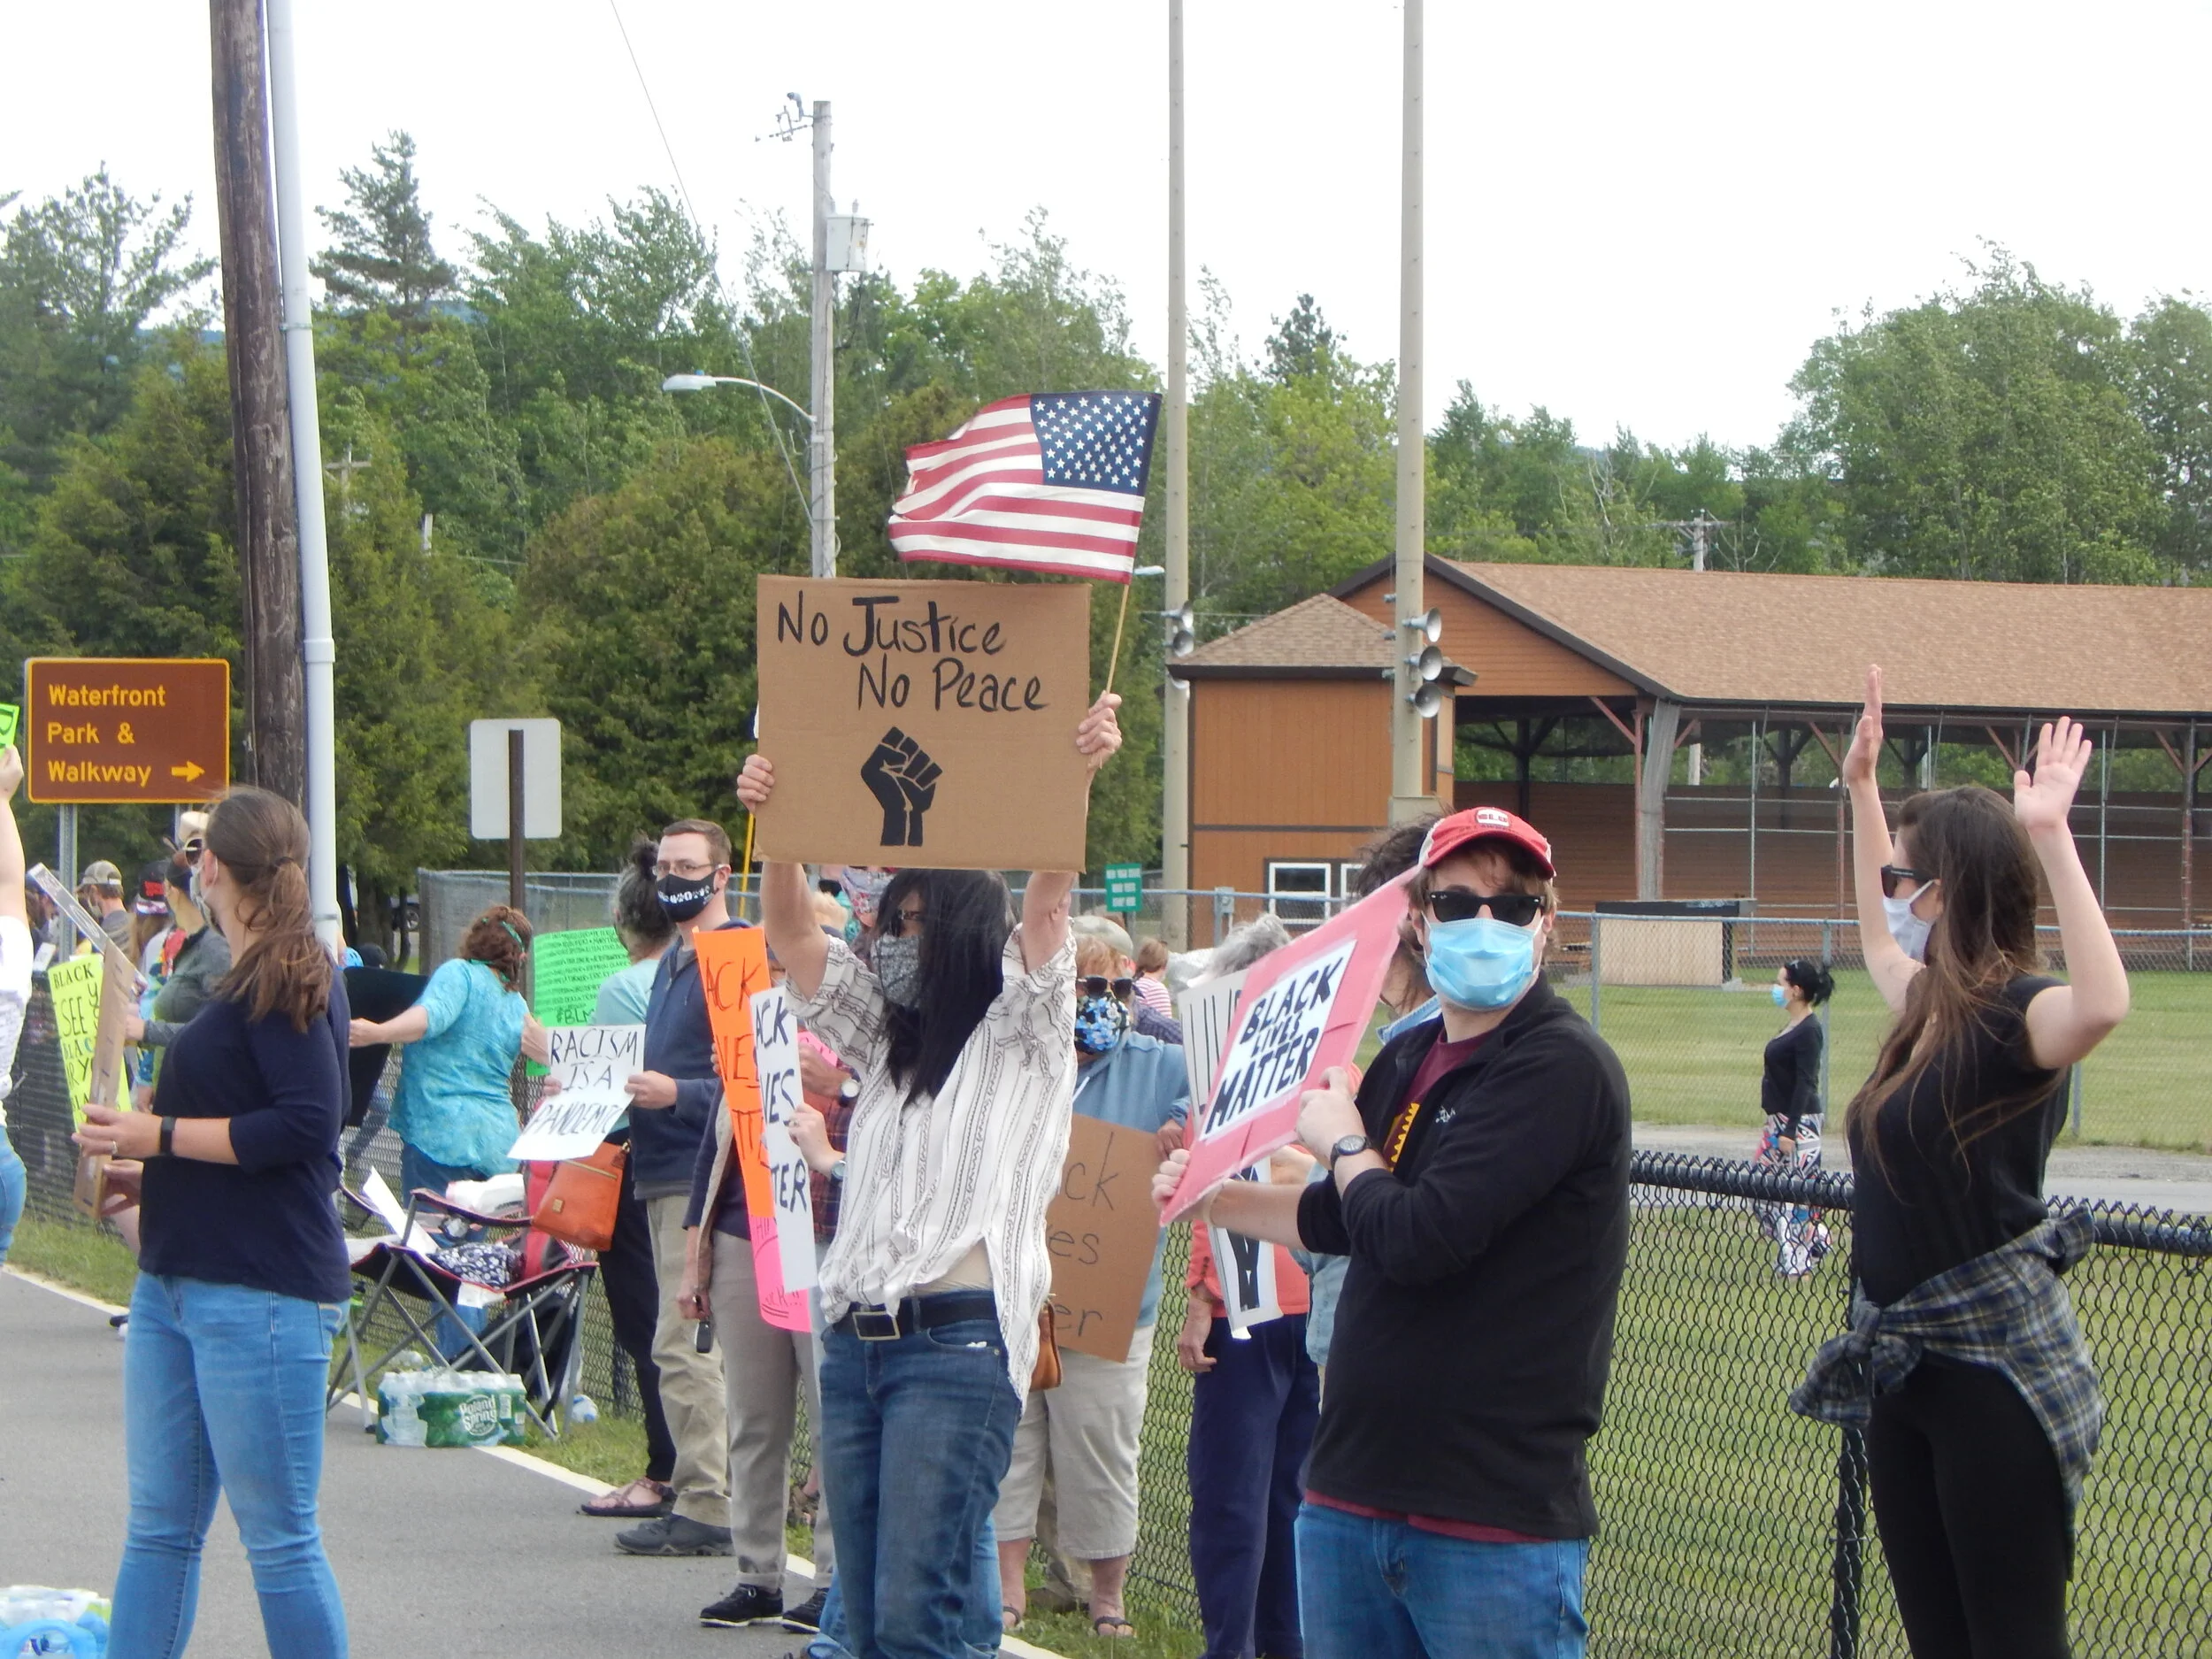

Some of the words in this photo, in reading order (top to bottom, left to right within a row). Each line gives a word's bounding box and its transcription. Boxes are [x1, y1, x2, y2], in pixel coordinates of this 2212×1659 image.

[777, 589, 829, 646] No
[842, 595, 1007, 657] Justice
[48, 684, 166, 707] Waterfront
[857, 652, 911, 711] No
[932, 657, 1050, 712] Peace
[47, 722, 100, 745] Park
[117, 722, 135, 745] &
[48, 760, 152, 787] Walkway
[52, 962, 96, 989] BLACK
[60, 996, 88, 1038] SEE
[1240, 956, 1344, 1044] BLACK
[756, 996, 788, 1046] ACK
[1250, 1010, 1303, 1058] LIVES
[63, 1035, 96, 1060] BLAC
[550, 1027, 638, 1066] RACISM
[562, 1060, 595, 1092] IS
[592, 1064, 612, 1091] A
[1205, 1026, 1320, 1135] MATTER
[1064, 1132, 1118, 1211] ck
[1048, 1230, 1100, 1265] es
[458, 1394, 496, 1414] Poland
[462, 1410, 497, 1432] Spring
